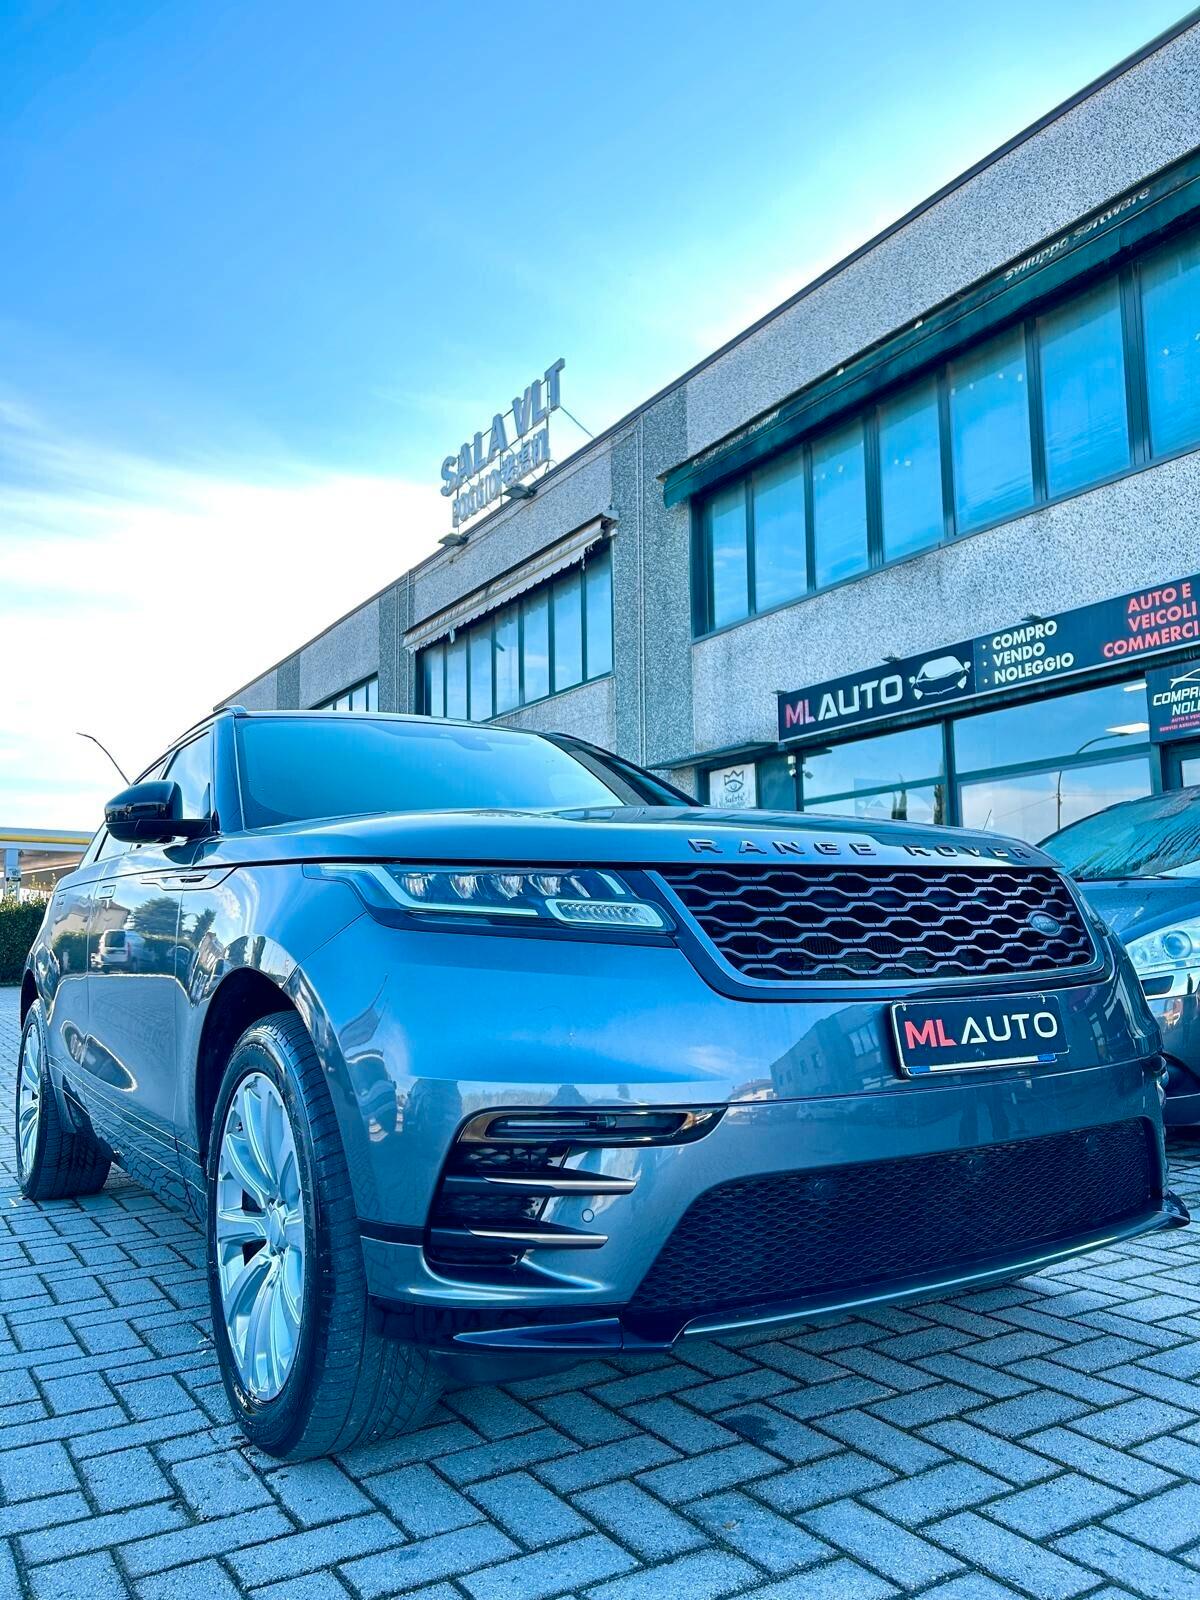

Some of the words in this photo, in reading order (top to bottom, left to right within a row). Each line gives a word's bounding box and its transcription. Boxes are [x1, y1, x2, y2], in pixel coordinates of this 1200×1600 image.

[1003, 237, 1070, 281] Sviluppo
[440, 413, 508, 497] SALA
[512, 357, 566, 439] VLT
[1127, 587, 1178, 614] AUTO
[1181, 582, 1192, 599] E
[1128, 601, 1197, 632] VEICOLI
[992, 620, 1058, 651] COMPRO
[1103, 620, 1199, 658] COMMERCI
[993, 642, 1046, 667] VENDO
[994, 652, 1075, 685] NOLEGGIO
[1153, 686, 1200, 706] COMPR
[687, 838, 877, 856] RANGE
[903, 843, 1031, 859] ROVER
[904, 1019, 958, 1049] ML
[961, 1012, 1058, 1045] AUTO
